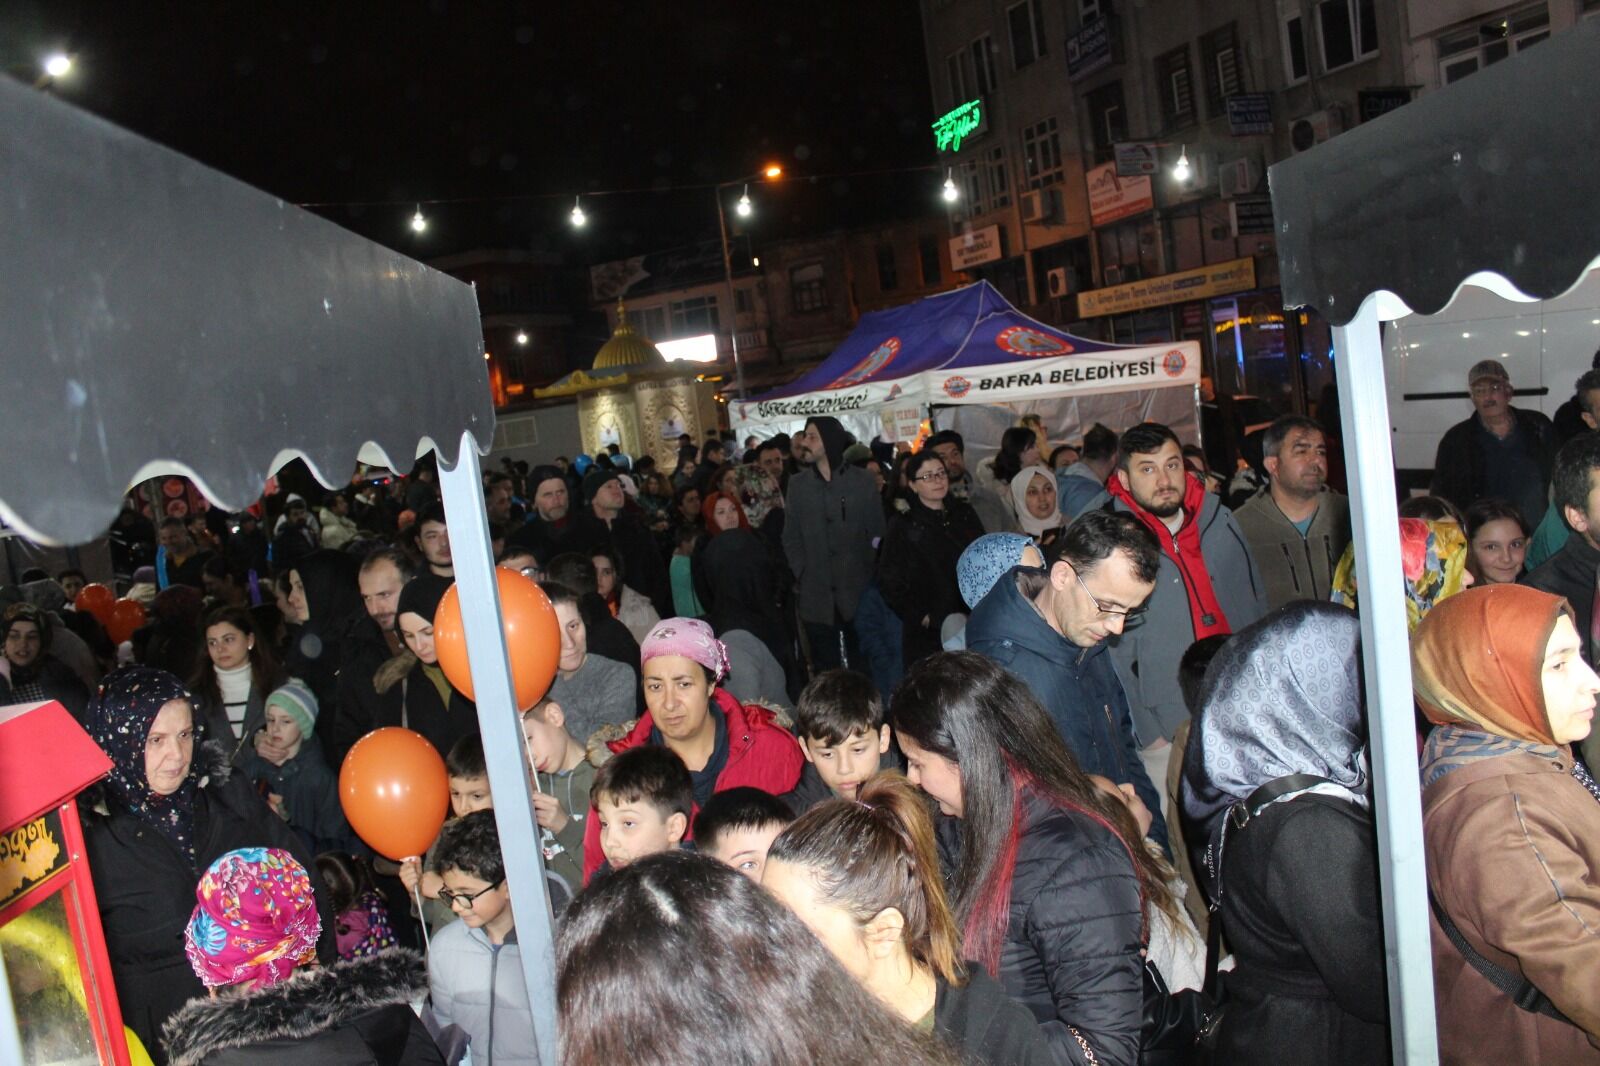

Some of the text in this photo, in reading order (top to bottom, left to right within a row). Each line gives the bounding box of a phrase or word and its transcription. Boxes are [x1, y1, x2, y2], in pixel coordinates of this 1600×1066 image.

[979, 372, 1043, 391] BAFRA
[1049, 356, 1156, 384] BELEDİYESİ
[1207, 843, 1215, 879] VISSONA
